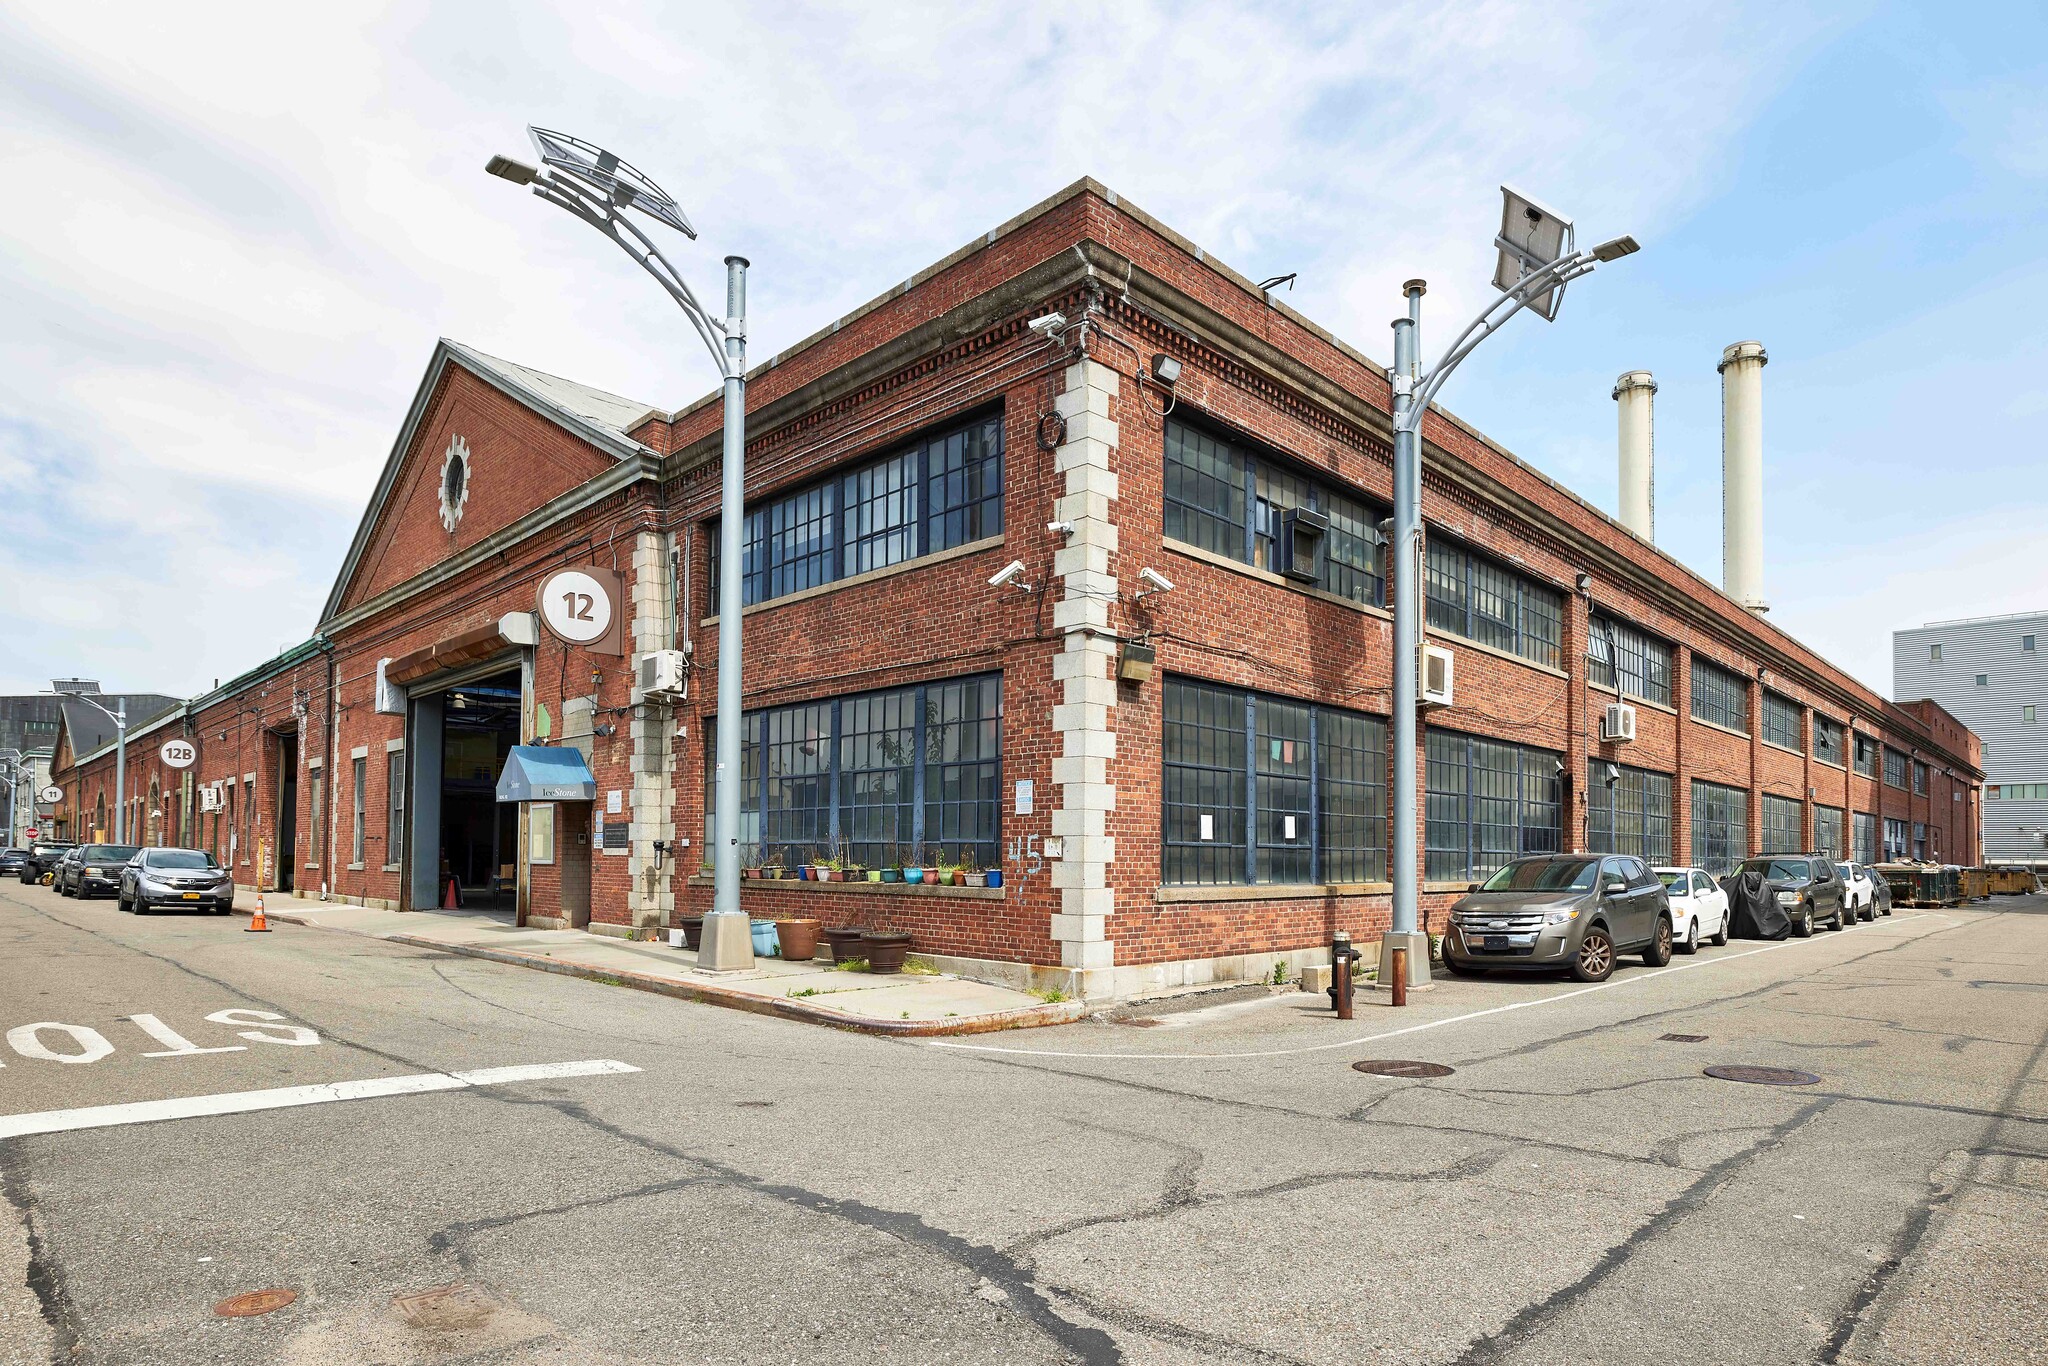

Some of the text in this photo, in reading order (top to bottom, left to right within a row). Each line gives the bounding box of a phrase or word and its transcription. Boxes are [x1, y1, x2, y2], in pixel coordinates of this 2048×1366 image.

[562, 592, 594, 622] 12
[166, 748, 192, 760] 12B
[543, 788, 577, 797] IceStone
[0, 1008, 321, 1067] STO
